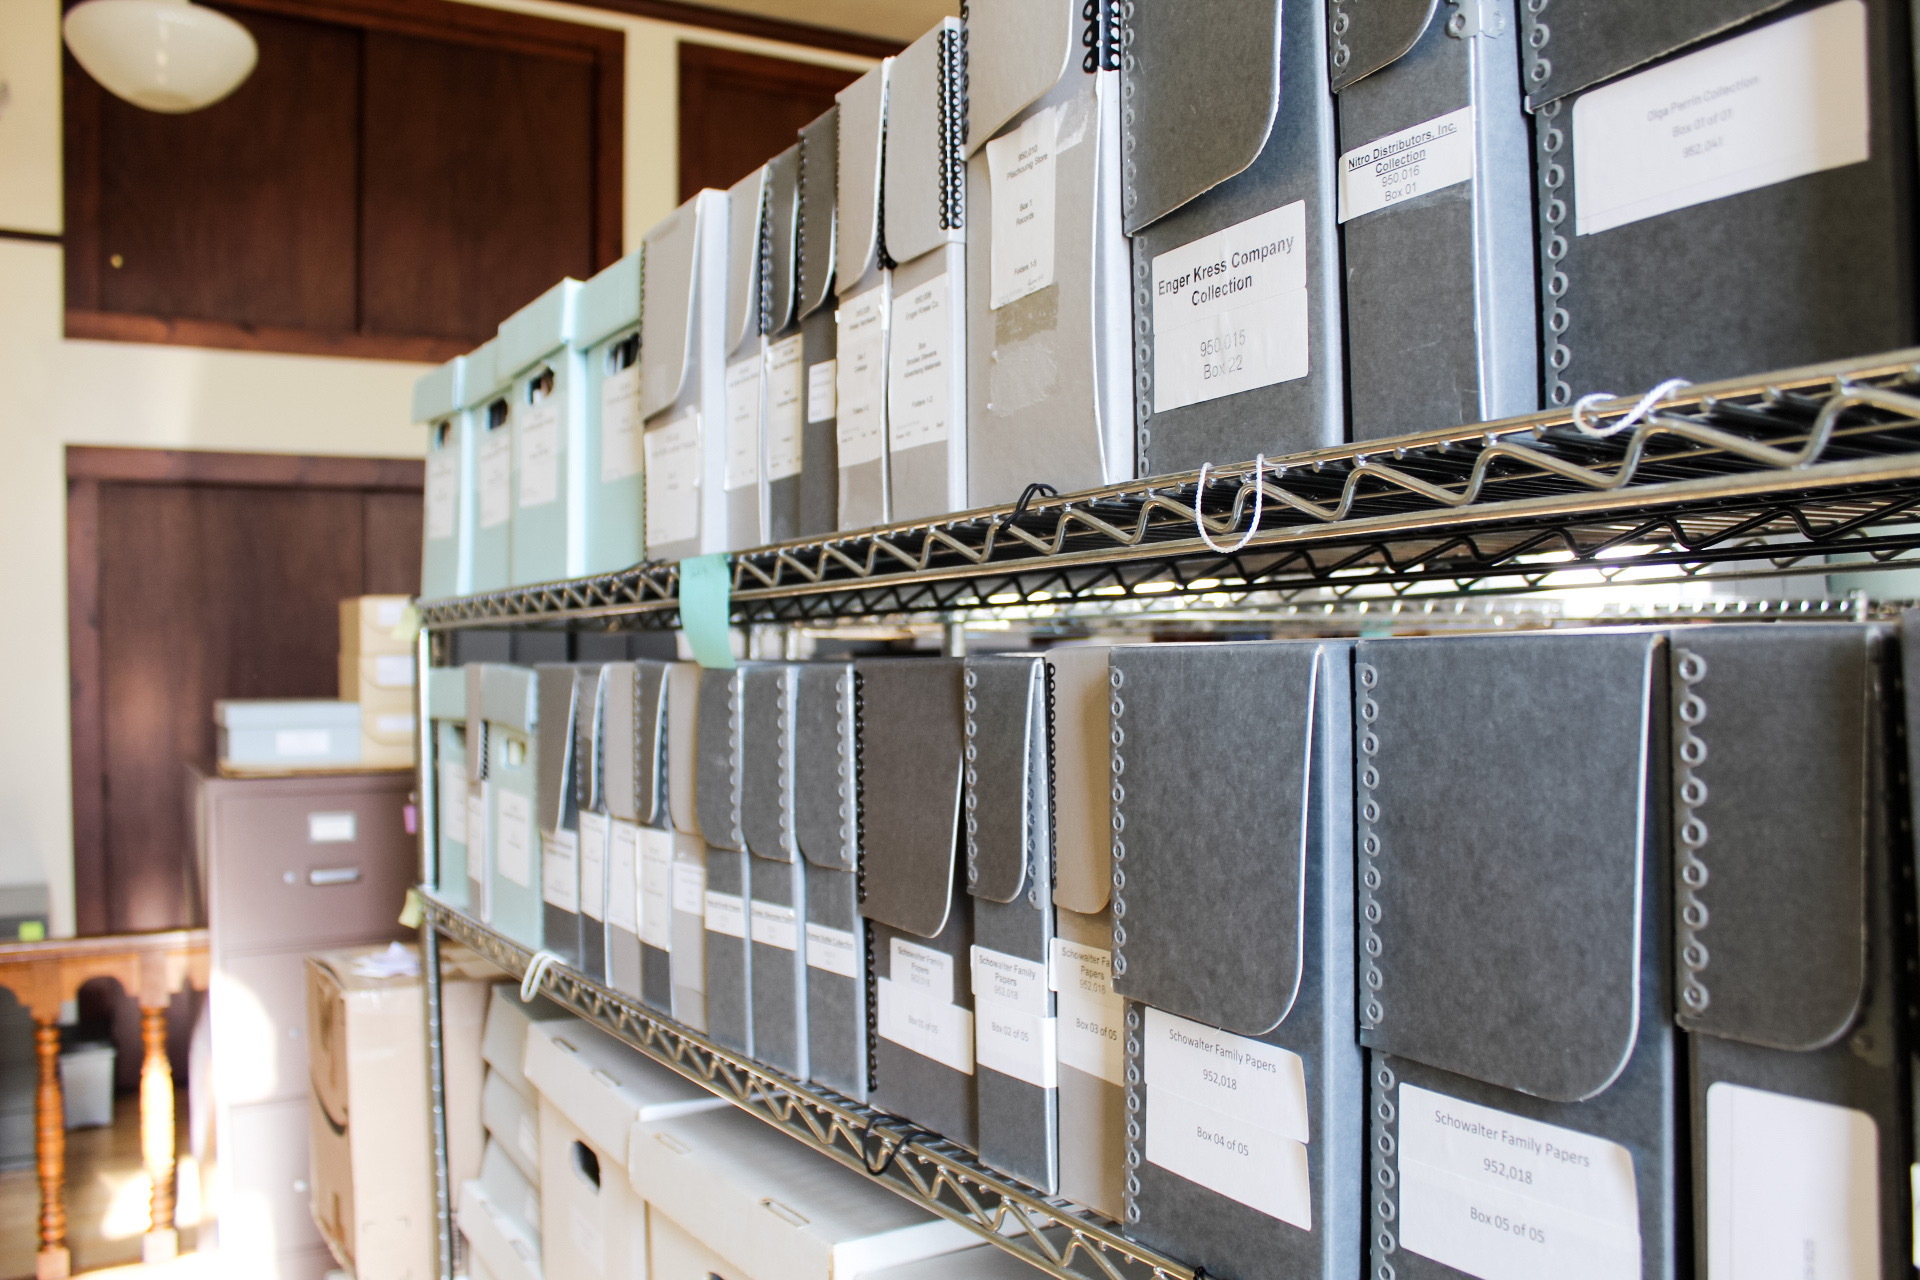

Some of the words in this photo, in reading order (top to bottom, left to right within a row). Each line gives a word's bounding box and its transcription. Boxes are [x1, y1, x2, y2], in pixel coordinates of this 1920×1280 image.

[1703, 75, 1759, 103] Collection
[1672, 124, 1692, 138] Box
[1706, 112, 1718, 126] of
[1348, 153, 1370, 169] Nitro
[1373, 131, 1434, 160] Distributors,
[1438, 122, 1457, 136] Inc.
[1376, 149, 1426, 174] Collection
[1385, 190, 1403, 202] Box
[1405, 182, 1417, 196] 01
[1158, 273, 1191, 296] Enger
[1193, 260, 1227, 283] Kress
[1231, 235, 1294, 268] Company
[1192, 275, 1252, 306] Collection
[1204, 362, 1225, 381] Box
[1228, 354, 1243, 374] 22
[995, 972, 1018, 987] Papers
[1013, 964, 1036, 981] Family
[1080, 965, 1105, 981] Papers
[991, 1021, 1003, 1034] Box
[1003, 1026, 1012, 1037] 02
[1013, 1029, 1020, 1038] of
[1020, 1031, 1029, 1042] 05
[1076, 1018, 1089, 1031] Box
[1089, 1022, 1099, 1034] 03
[1099, 1027, 1108, 1038] of
[1108, 1029, 1117, 1041] 05
[1169, 1028, 1214, 1053] Schowalter
[1215, 1044, 1243, 1065] Family
[1245, 1055, 1277, 1074] Papers
[1202, 1069, 1237, 1091] 952,018
[1197, 1126, 1212, 1142] Box
[1213, 1132, 1225, 1147] 04
[1226, 1139, 1236, 1151] of
[1237, 1144, 1249, 1156] 05
[1435, 1110, 1498, 1141] Schowalter
[1501, 1130, 1542, 1155] Family
[1545, 1142, 1590, 1168] Papers
[1483, 1158, 1533, 1185] 952,018
[1470, 1206, 1491, 1225] Box
[1494, 1215, 1509, 1231] 05
[1513, 1222, 1526, 1237] of
[1529, 1226, 1545, 1244] 05
